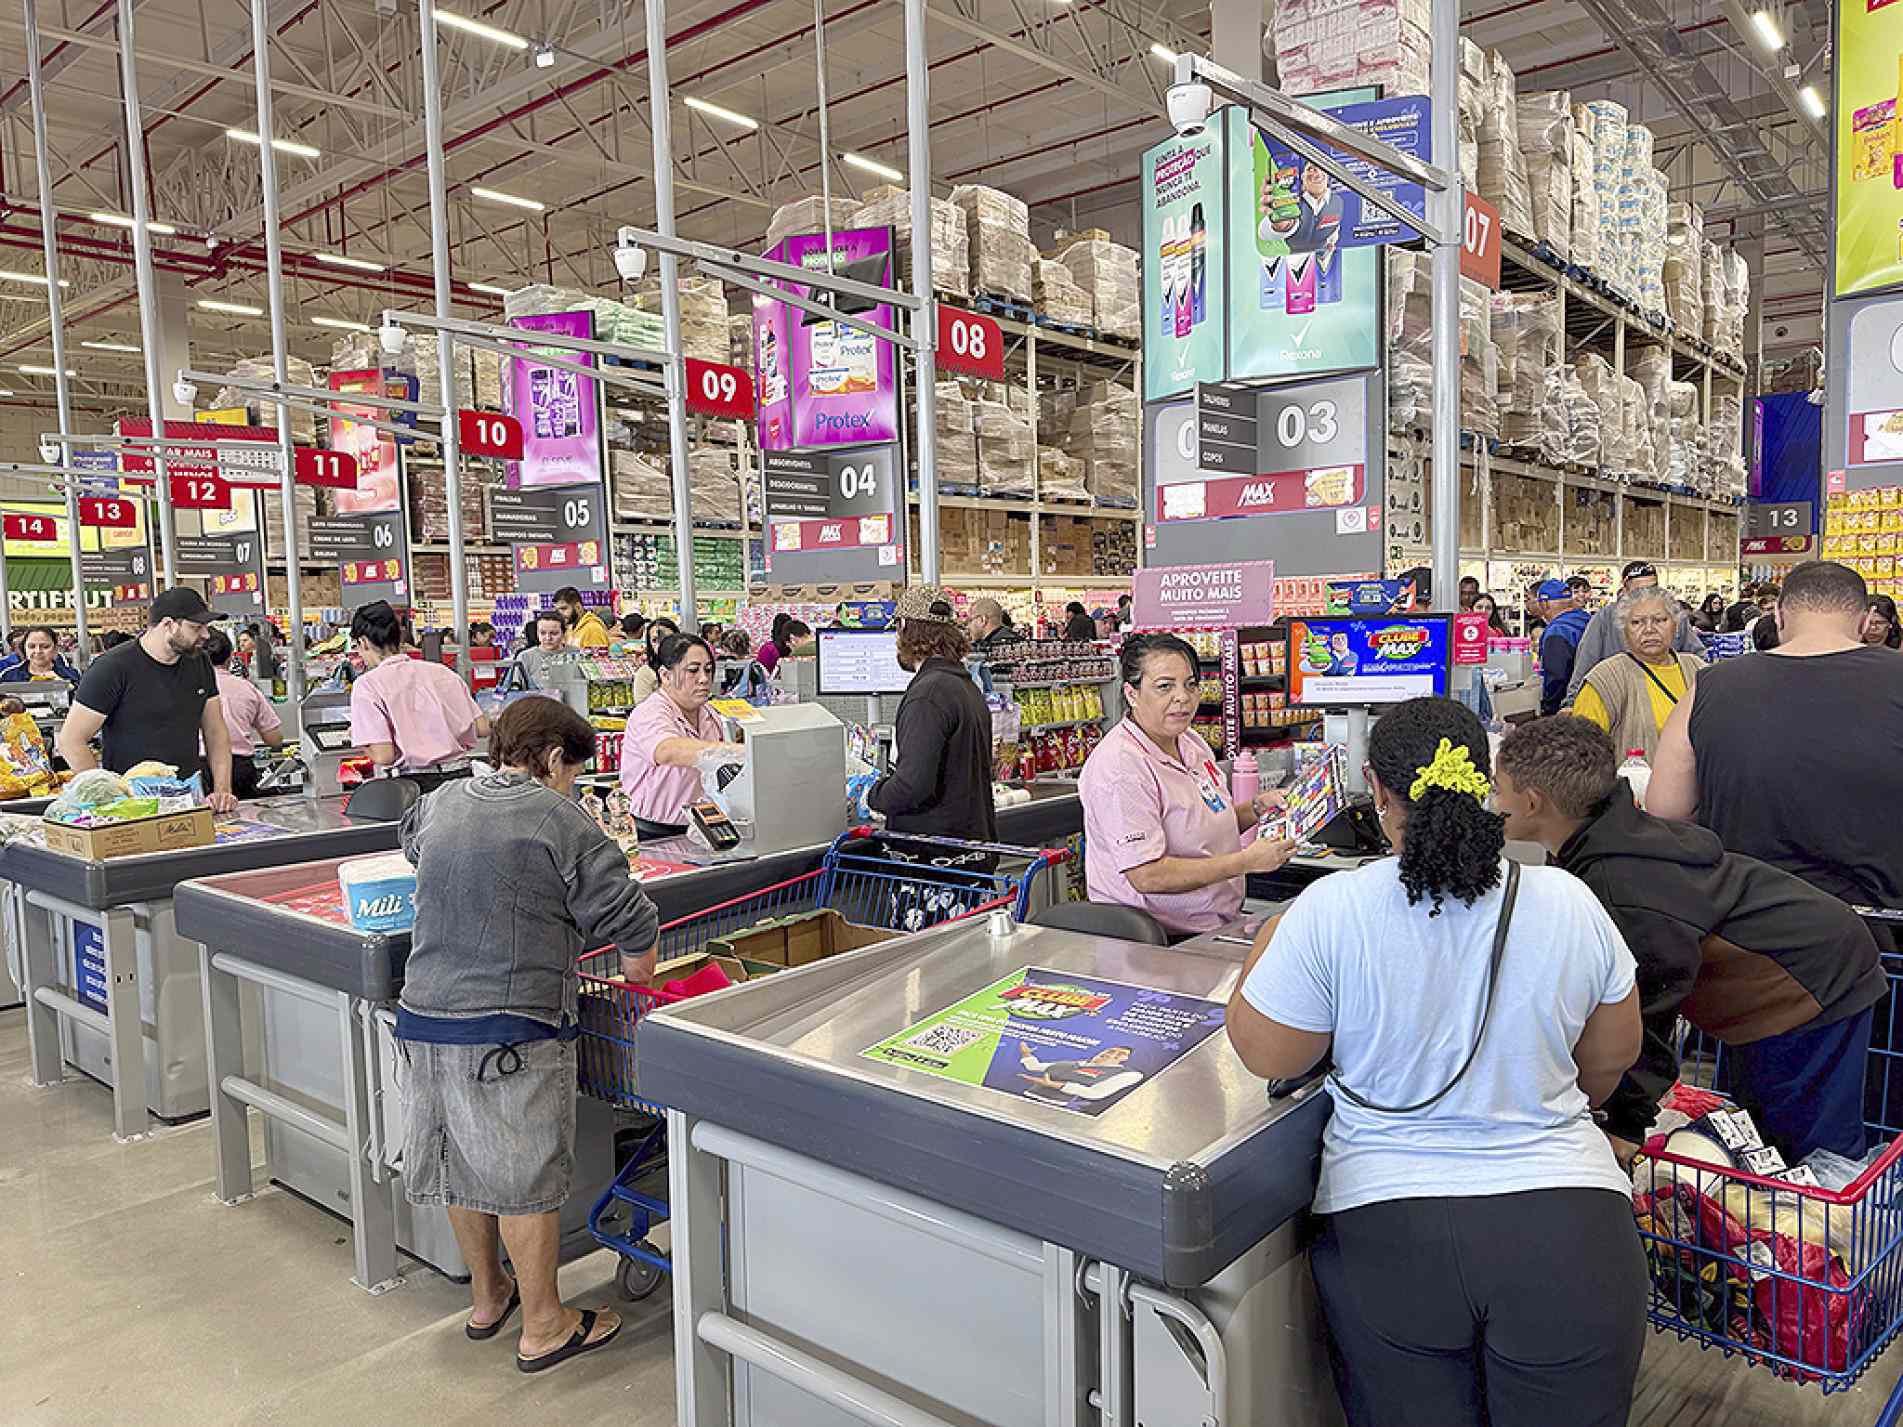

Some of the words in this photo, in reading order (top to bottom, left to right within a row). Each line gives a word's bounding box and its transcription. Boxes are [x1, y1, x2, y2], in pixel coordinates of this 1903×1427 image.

[1466, 207, 1490, 257] 07
[951, 319, 986, 359] 08
[703, 369, 737, 402] 09
[815, 411, 871, 429] Protex
[1276, 400, 1340, 447] 03
[476, 419, 507, 446] 10
[314, 455, 339, 477] 11
[187, 481, 216, 500] 12
[841, 463, 877, 499] 04
[1237, 482, 1275, 507] MAX
[94, 502, 121, 519] 13
[564, 499, 590, 528] 05
[1769, 509, 1798, 527] 13
[18, 518, 43, 534] 14
[374, 524, 393, 548] 06
[237, 542, 250, 563] 07
[1160, 569, 1242, 587] APROVEITE
[1160, 588, 1204, 602] MUITO
[1207, 585, 1242, 600] MAIS
[1223, 639, 1235, 671] MAIS
[1375, 642, 1418, 660] MAX
[1224, 673, 1236, 715] MUITO
[356, 894, 404, 919] Mili
